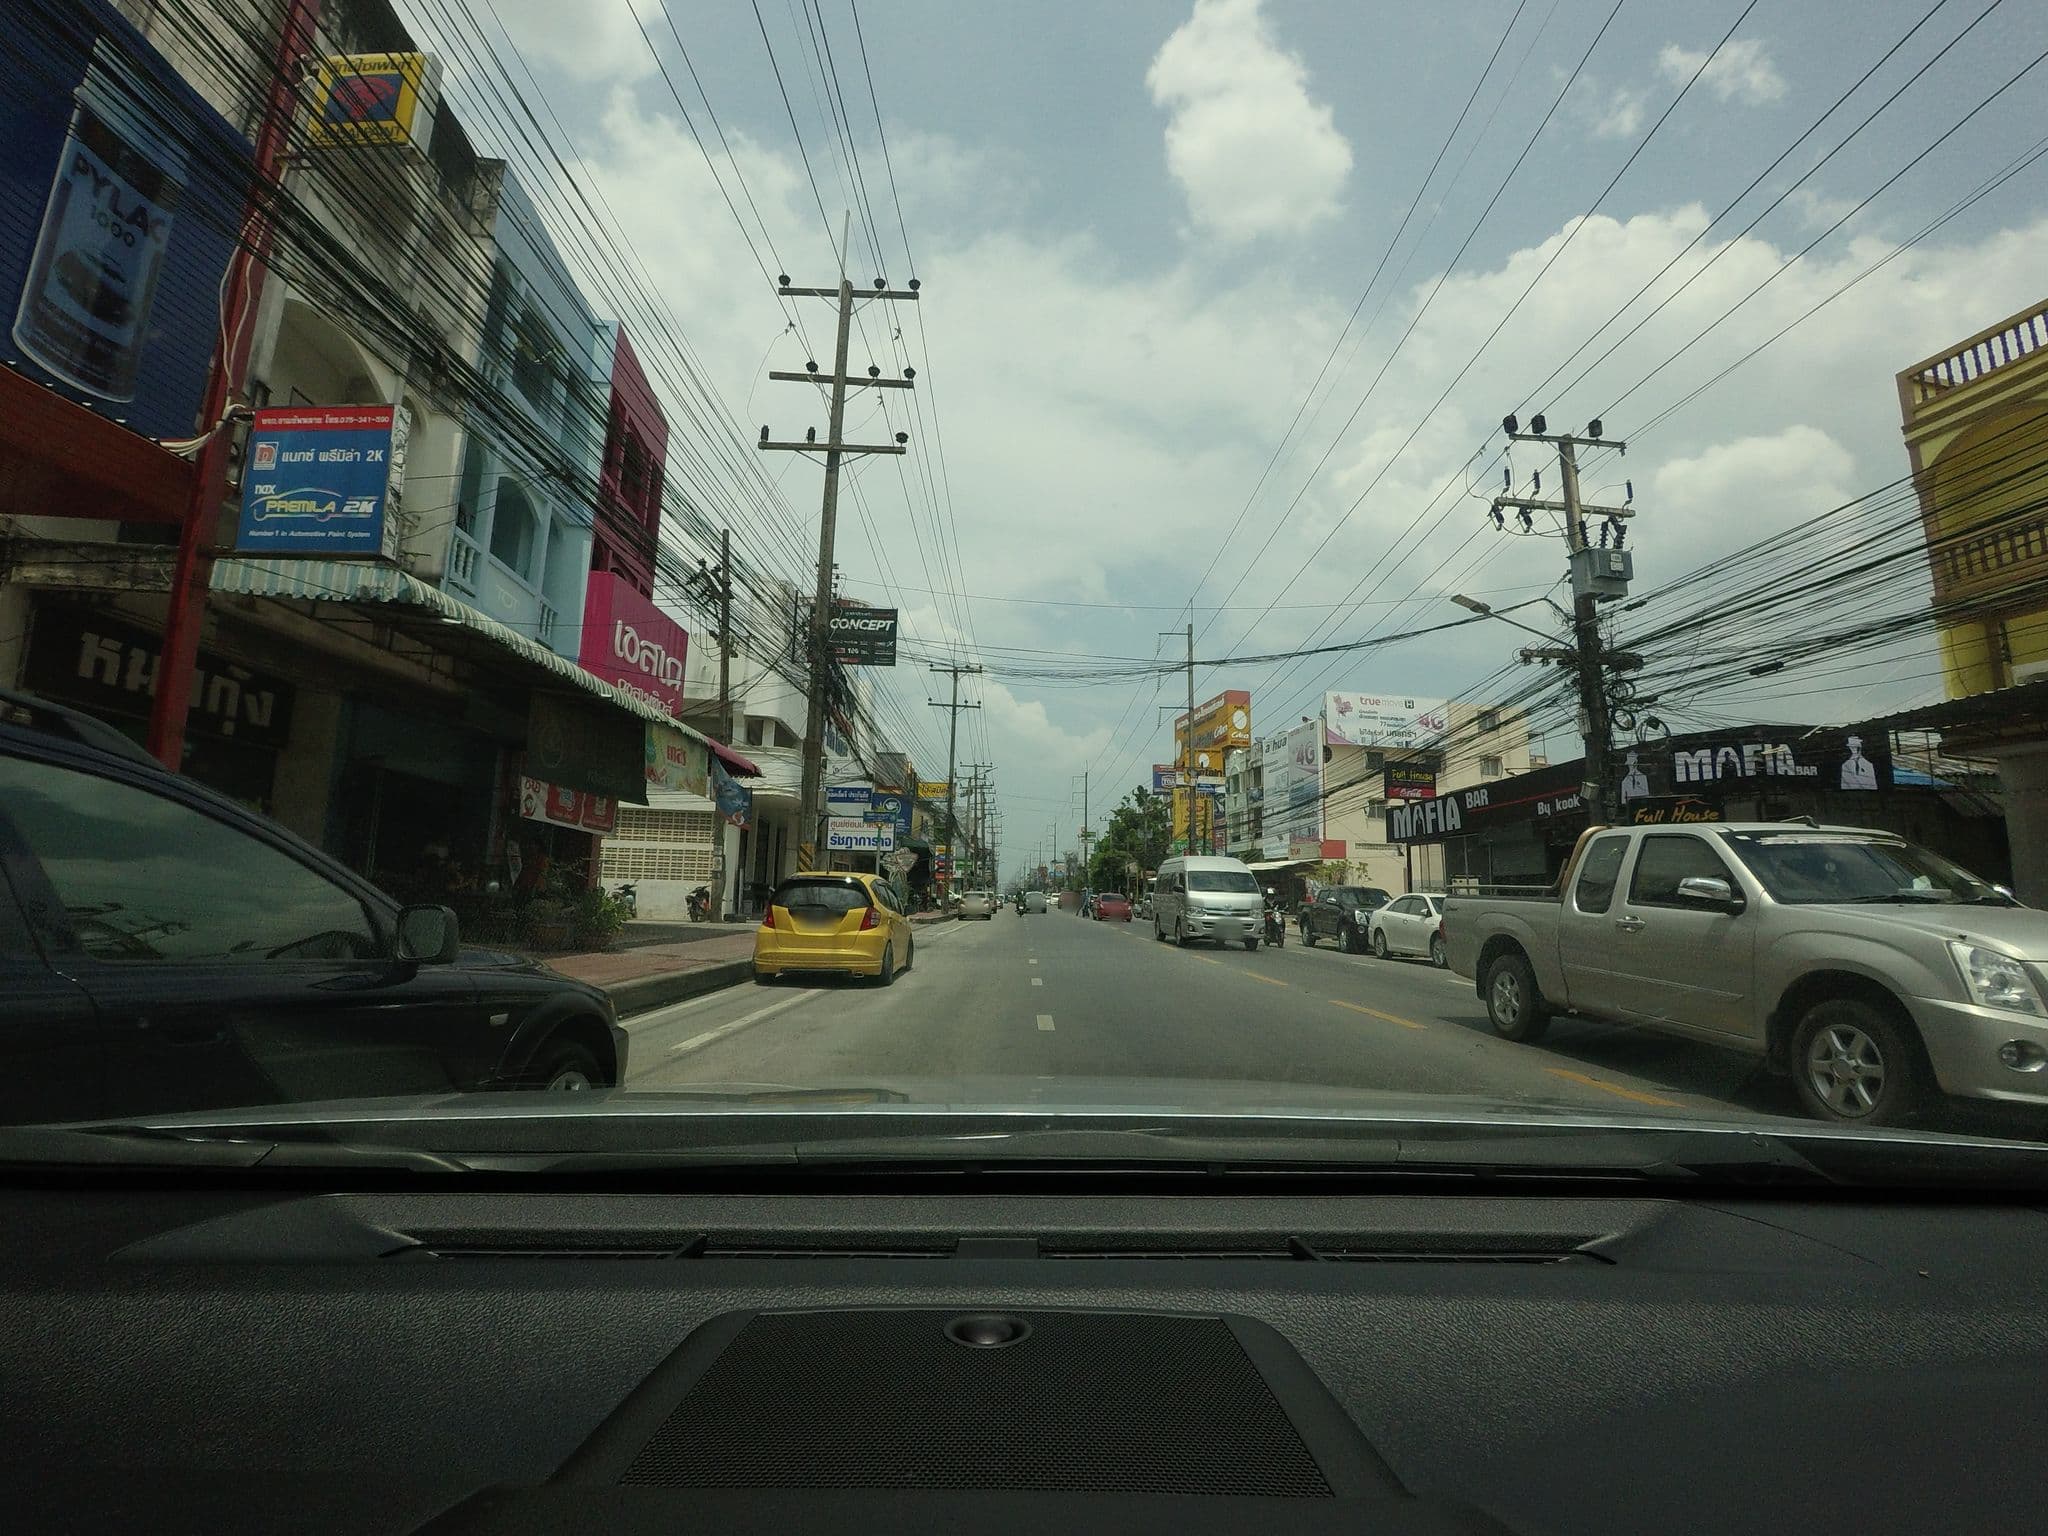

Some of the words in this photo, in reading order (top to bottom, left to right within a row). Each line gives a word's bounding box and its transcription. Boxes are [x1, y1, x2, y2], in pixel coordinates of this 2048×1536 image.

[366, 449, 384, 462] 2K
[342, 500, 377, 513] 2K
[829, 617, 895, 632] CONCEPT
[1674, 743, 1797, 782] MAFIA
[1796, 765, 1818, 776] BAR
[1393, 796, 1462, 839] MAFIA
[1465, 788, 1489, 809] BAR
[1537, 801, 1551, 816] By
[1634, 807, 1665, 823] Full
[1671, 804, 1720, 823] House
